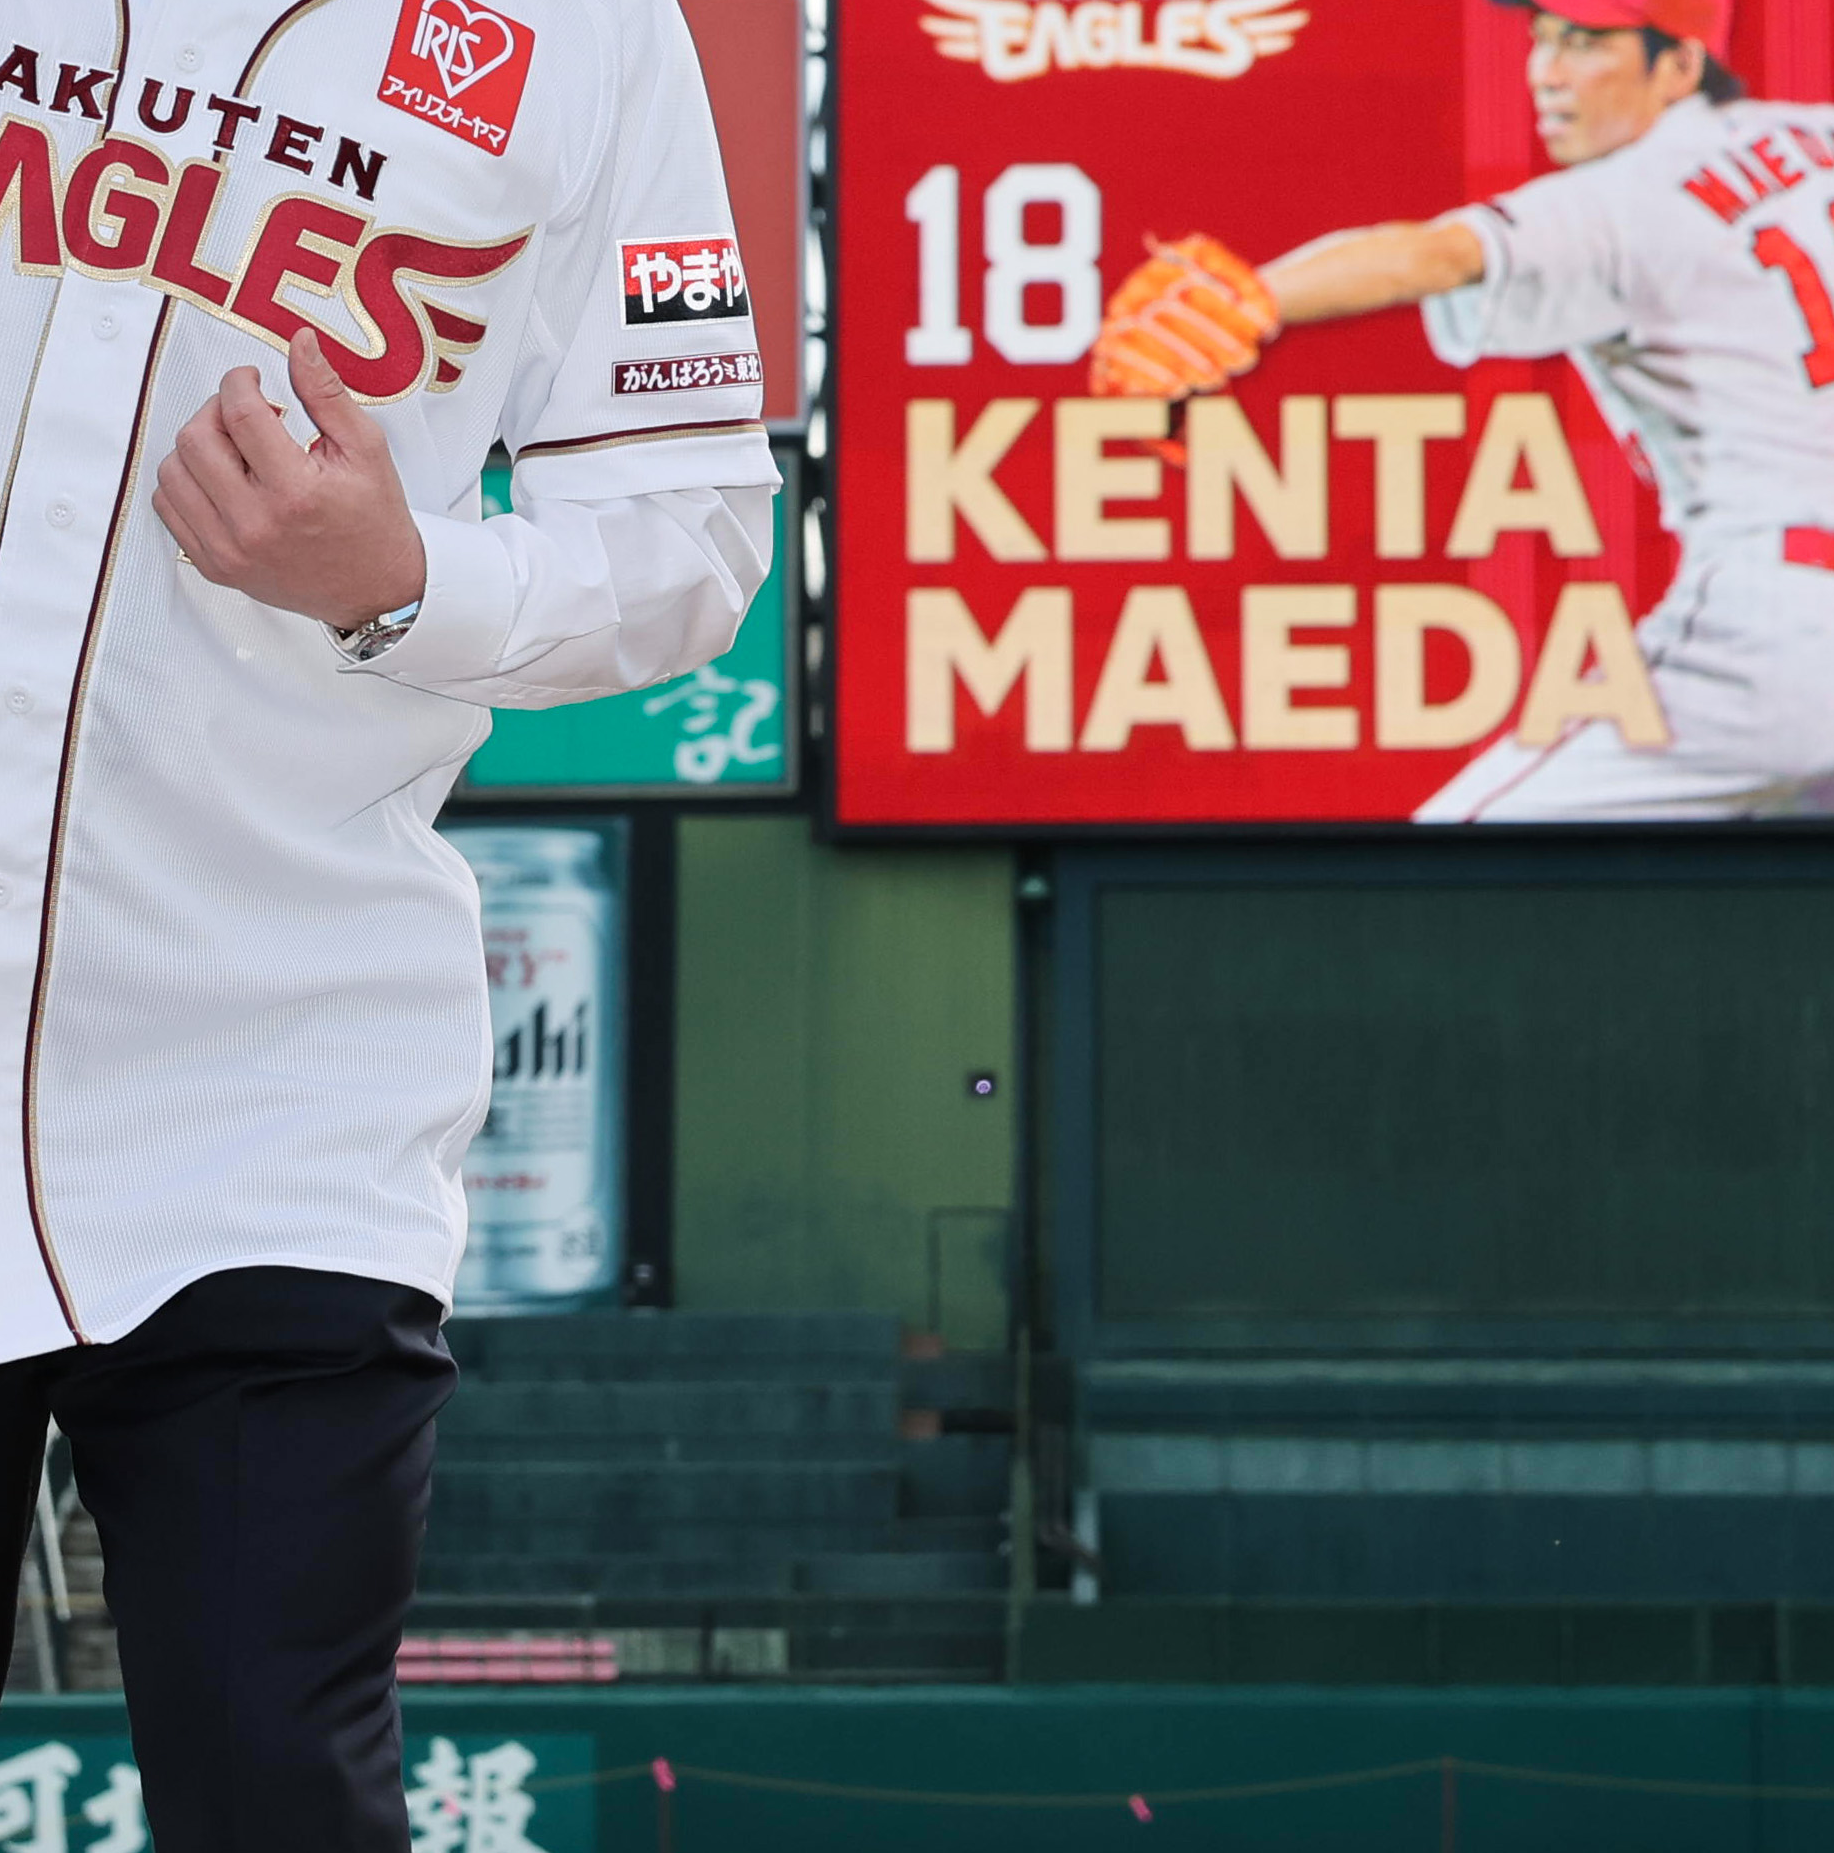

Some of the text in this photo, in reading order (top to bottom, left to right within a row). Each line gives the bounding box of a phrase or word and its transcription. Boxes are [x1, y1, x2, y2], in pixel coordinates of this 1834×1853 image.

[411, 8, 481, 77] IRIS
[382, 75, 507, 149] アイリスオーヤマ
[630, 247, 744, 314] やまや
[905, 162, 1102, 367] 18
[622, 354, 760, 391] がんばろう 東北
[904, 392, 1603, 562] KENTA
[904, 581, 1673, 753] MAEDA
[491, 999, 586, 1082] ahi
